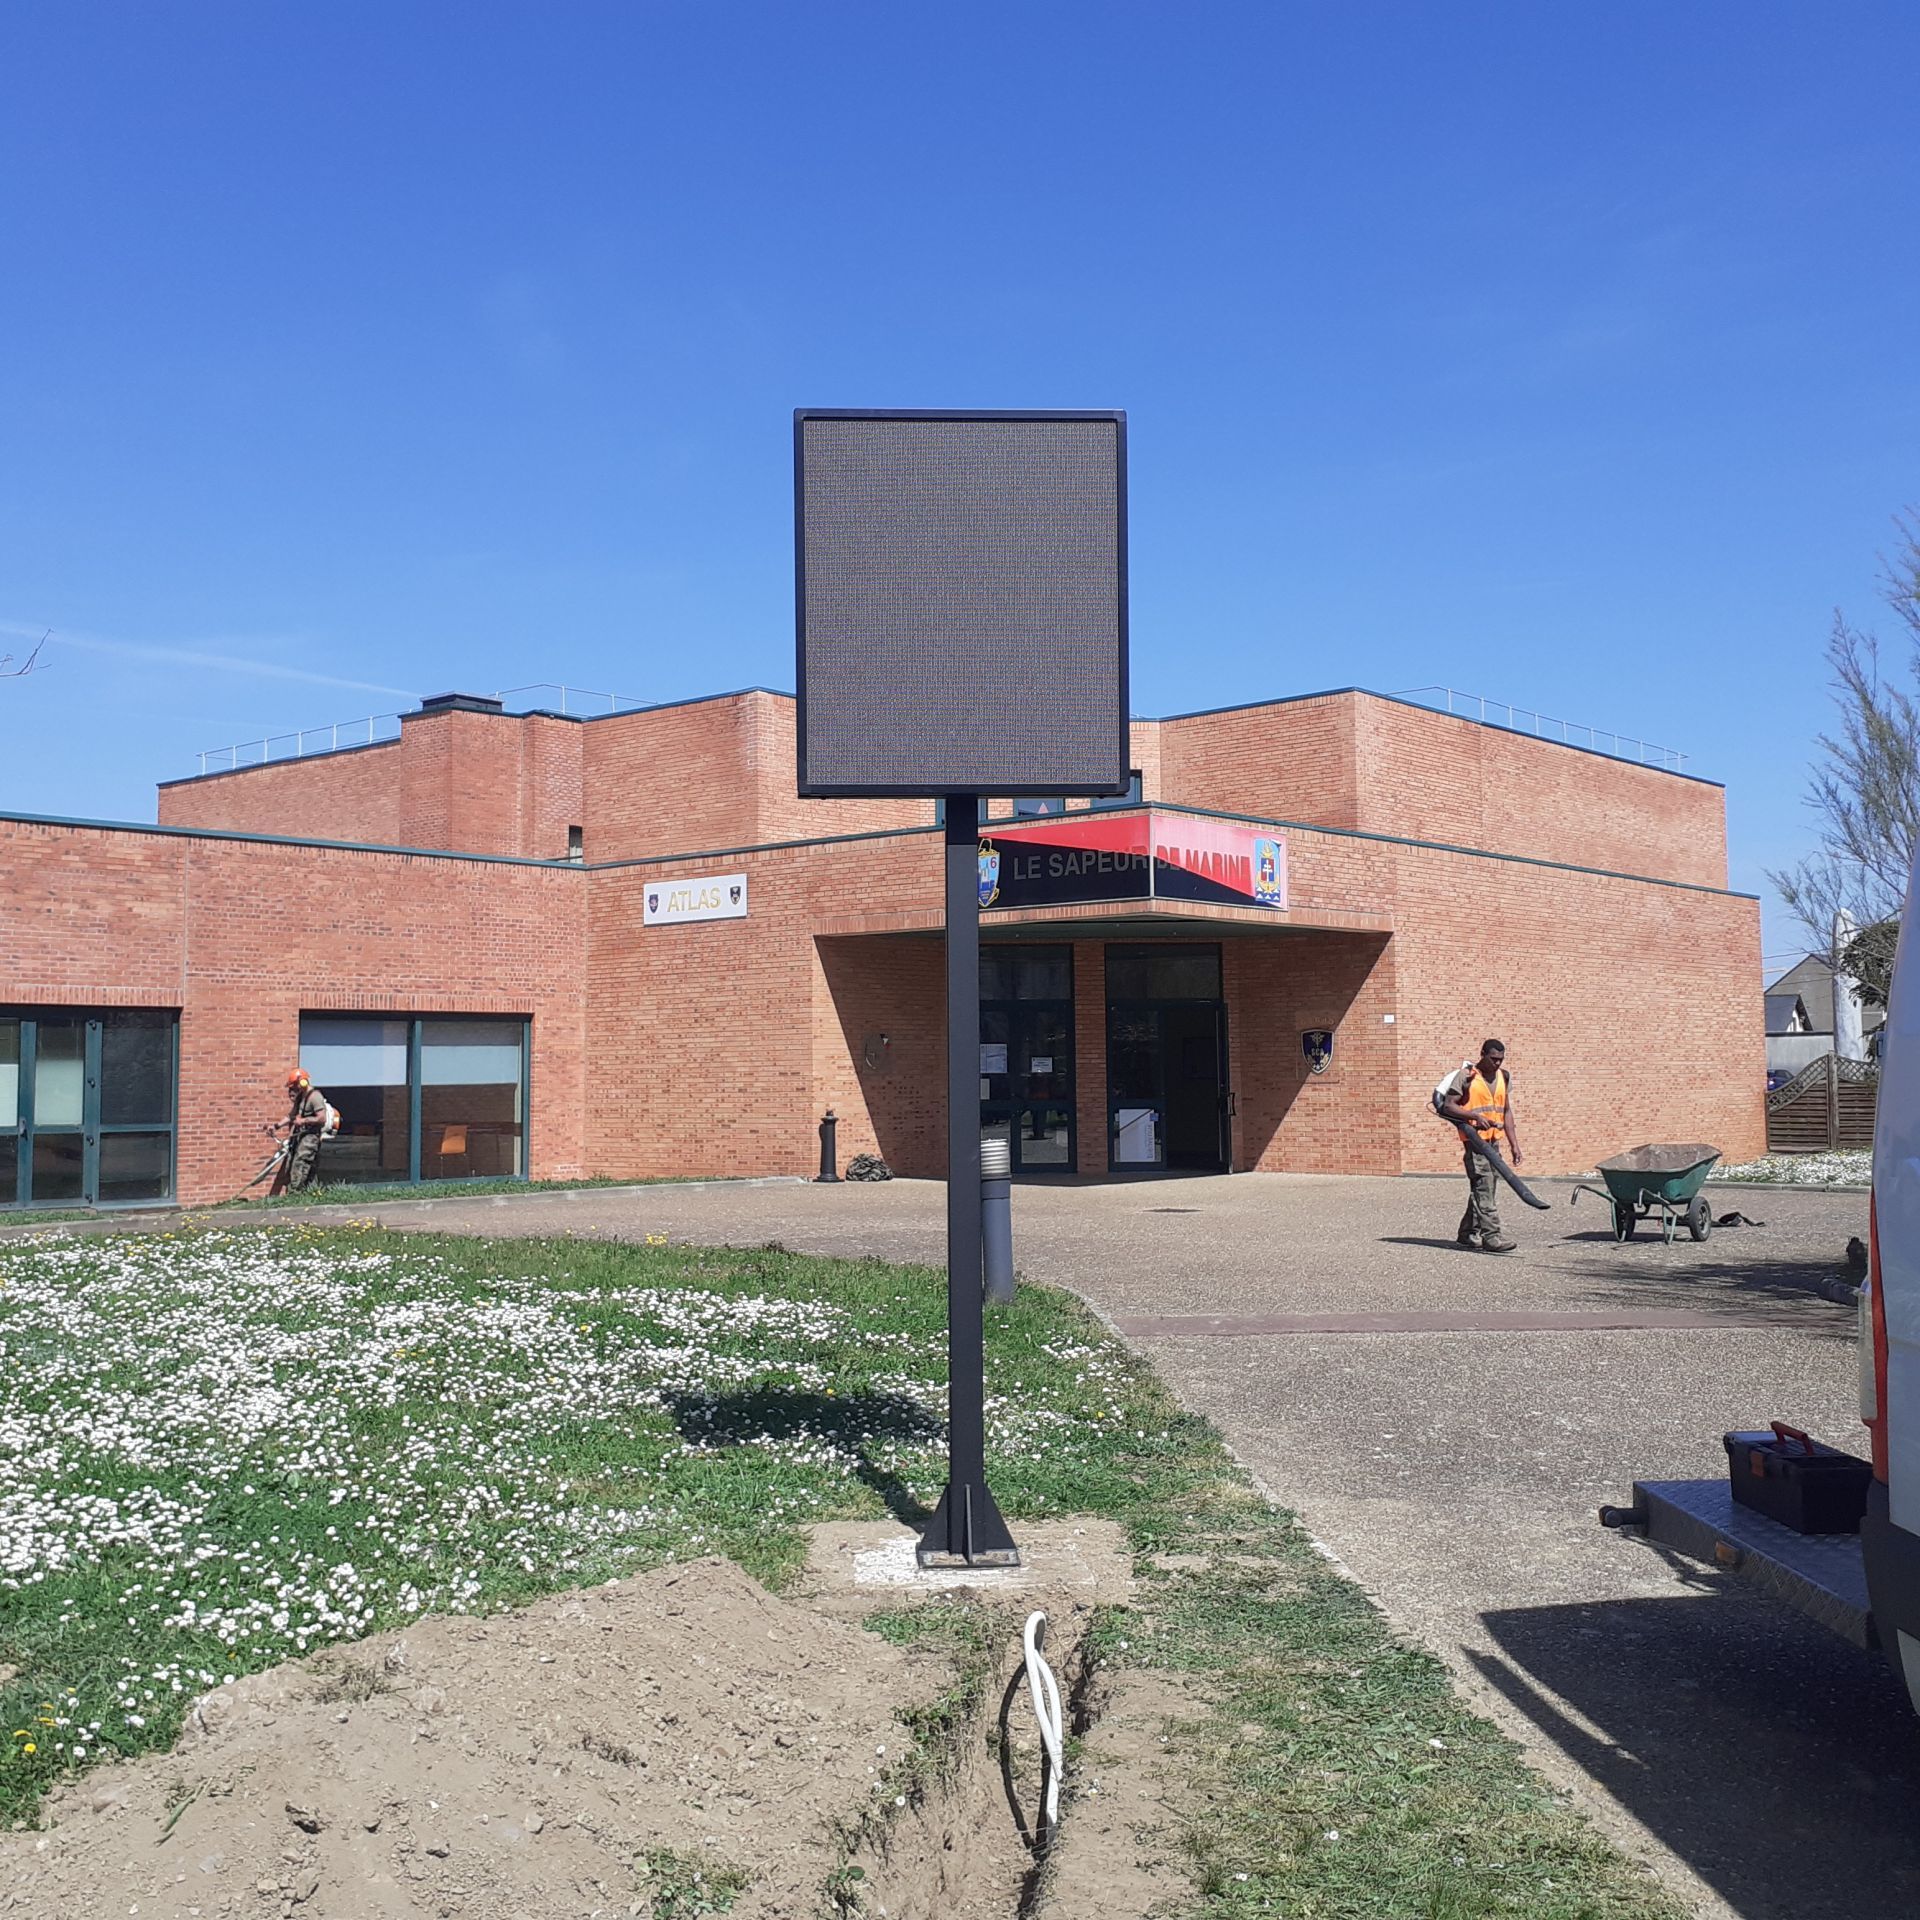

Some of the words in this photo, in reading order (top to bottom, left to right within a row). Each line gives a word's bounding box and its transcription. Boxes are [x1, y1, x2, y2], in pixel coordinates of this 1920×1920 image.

[990, 856, 997, 869] 6
[1013, 856, 1042, 880] LE
[1048, 845, 1148, 878] SAPEUR
[1156, 845, 1180, 870] DE
[1186, 848, 1251, 880] MARINE
[667, 887, 721, 912] ATLAS
